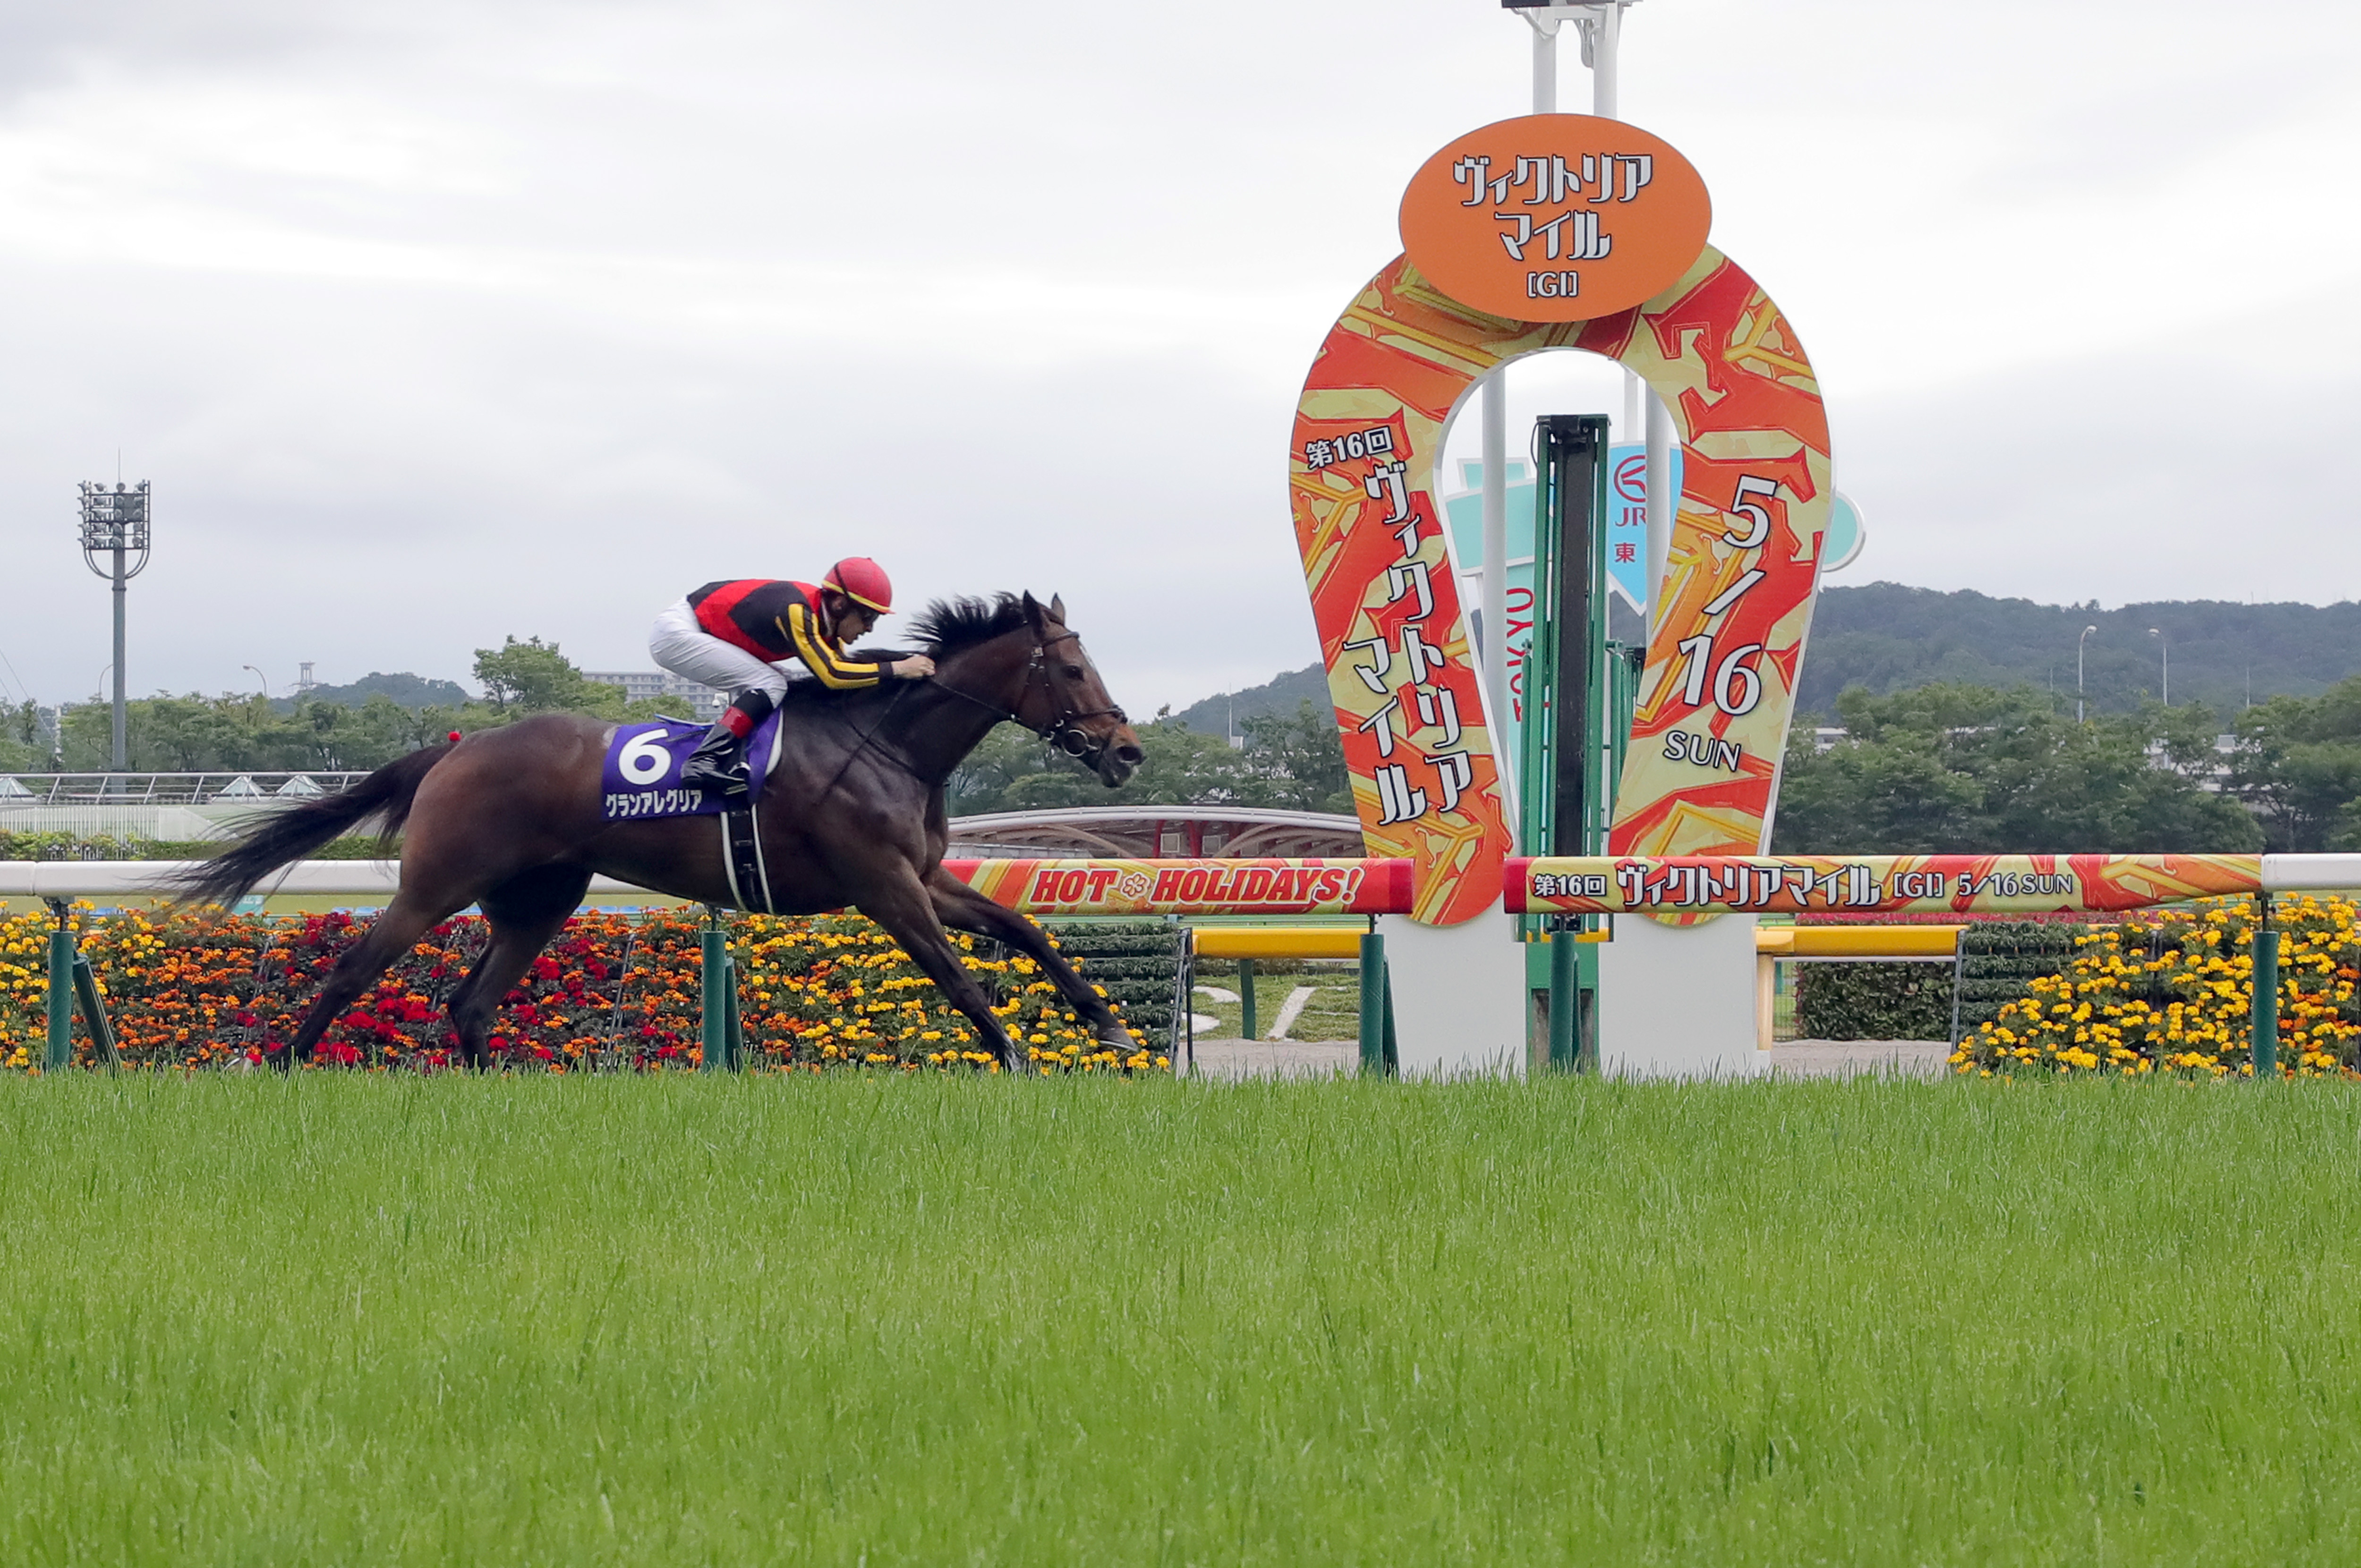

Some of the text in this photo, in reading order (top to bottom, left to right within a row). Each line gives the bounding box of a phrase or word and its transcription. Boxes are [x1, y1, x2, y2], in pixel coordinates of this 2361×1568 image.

[1452, 153, 1653, 206] ヴィクトリア
[1493, 210, 1611, 261] マイル
[1305, 426, 1393, 469] 第16回
[1614, 542, 1636, 563] 東
[1364, 460, 1473, 812] ヴィクトリア
[1343, 636, 1427, 826] マイル
[1662, 730, 1741, 772] SUN
[618, 728, 671, 785] 6
[605, 788, 702, 818] グランアレグリア
[1029, 867, 1366, 905] HOT HOLIDAYS!
[1533, 874, 1607, 897] 第16回
[1616, 863, 1882, 906] ヴィクトリアマイル
[1958, 871, 2018, 896] 5/16
[2021, 873, 2073, 895] SUN
